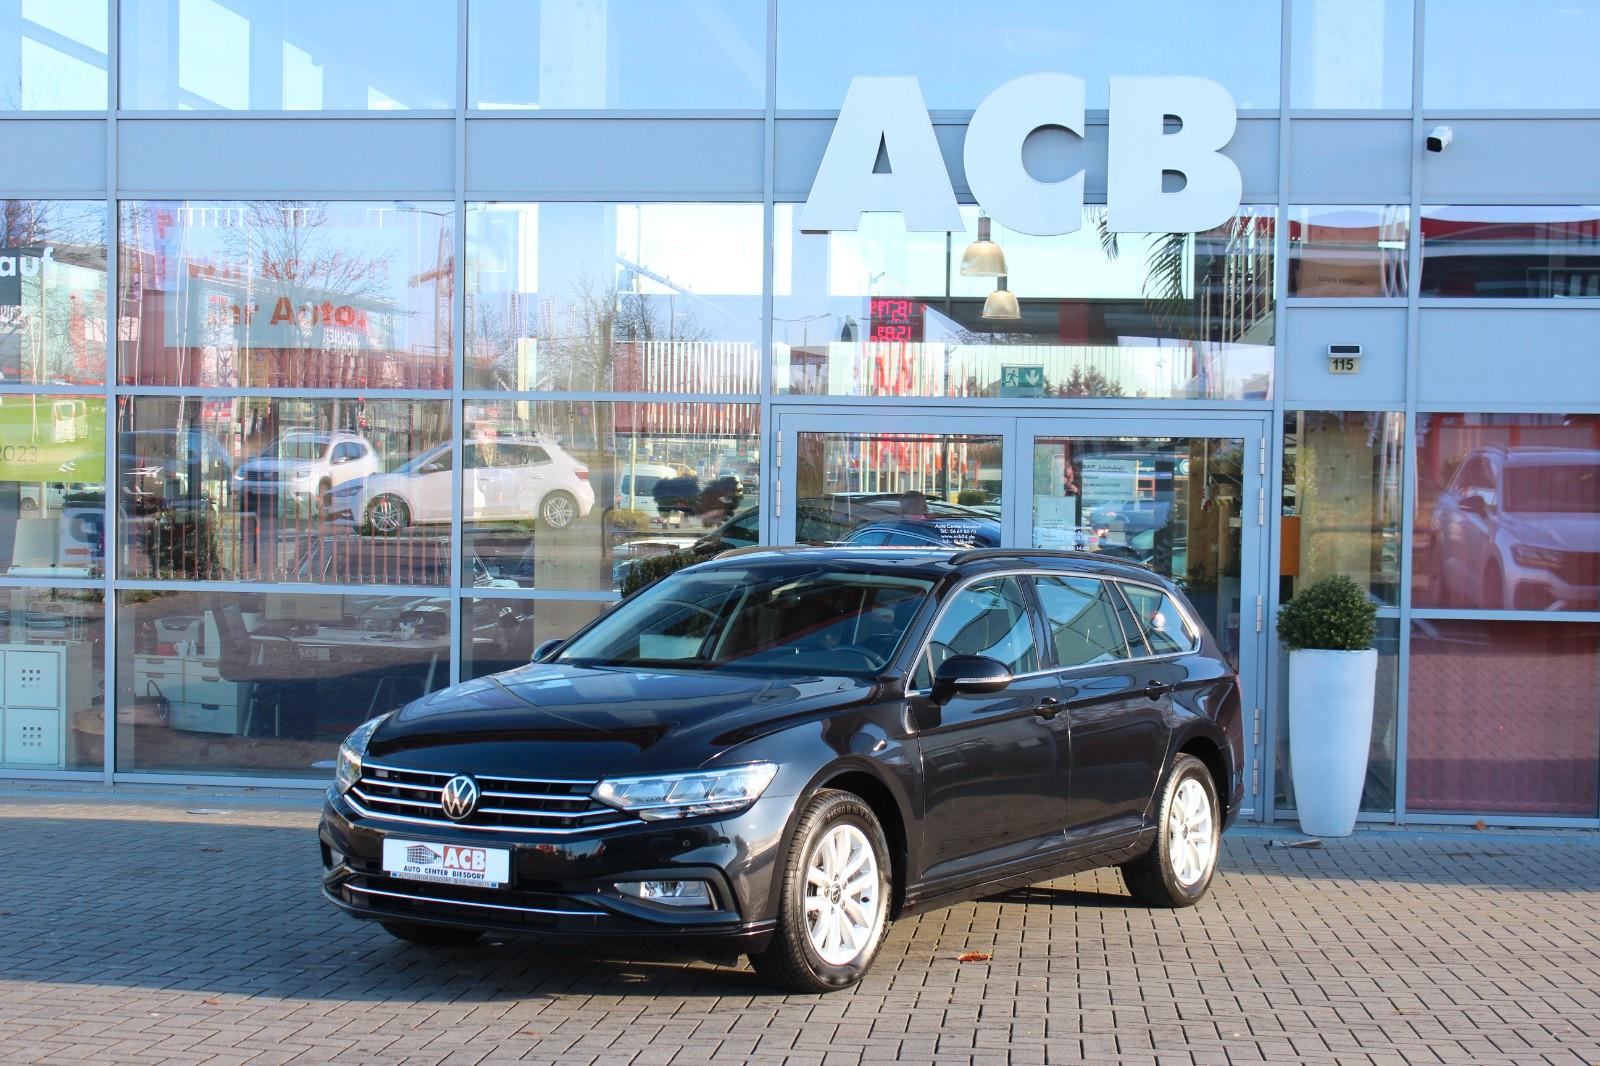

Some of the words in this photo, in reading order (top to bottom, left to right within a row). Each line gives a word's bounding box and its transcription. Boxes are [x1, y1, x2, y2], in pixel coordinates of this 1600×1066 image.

[799, 72, 1243, 236] ACB
[1332, 358, 1354, 371] 115
[445, 847, 486, 871] ACB
[403, 865, 421, 873] AUTO
[425, 868, 449, 876] CENTER
[452, 872, 486, 880] BIESDORF
